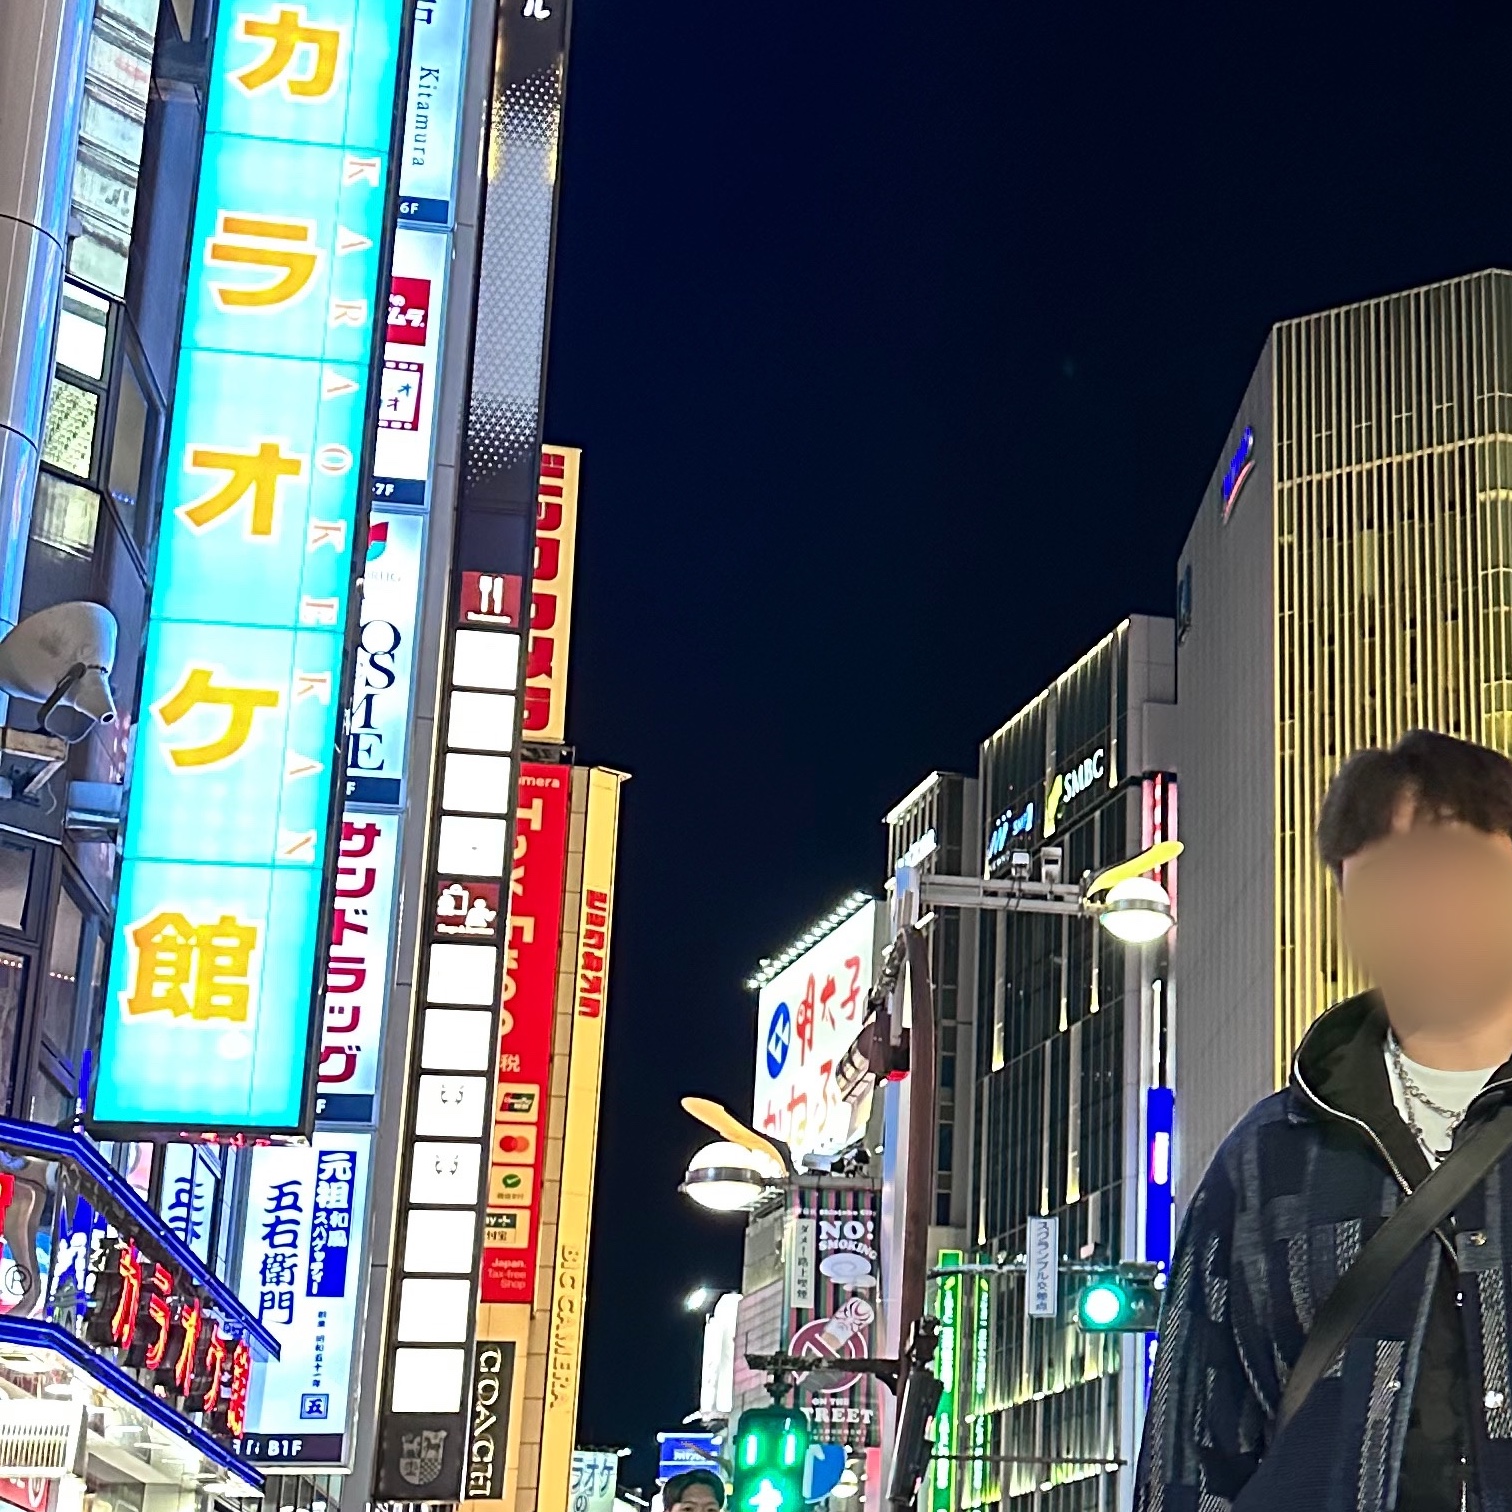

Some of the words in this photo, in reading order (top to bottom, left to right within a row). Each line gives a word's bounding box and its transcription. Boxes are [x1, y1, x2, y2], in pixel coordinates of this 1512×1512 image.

[411, 65, 440, 167] Kitamura
[399, 202, 419, 214] 6F
[302, 156, 379, 626] KARAOKE
[124, 8, 341, 1025] カラオケ館
[276, 670, 331, 863] KAN
[1063, 748, 1105, 804] SMBC
[317, 820, 382, 1084] サンドラッグ
[796, 955, 861, 1067] 明太子
[315, 1152, 353, 1209] 元祖
[818, 1220, 875, 1241] NO!
[258, 1180, 304, 1325] 五右衛門
[818, 1239, 878, 1260] SMOKING
[468, 1344, 502, 1497] COACH
[799, 1406, 874, 1425] TREET
